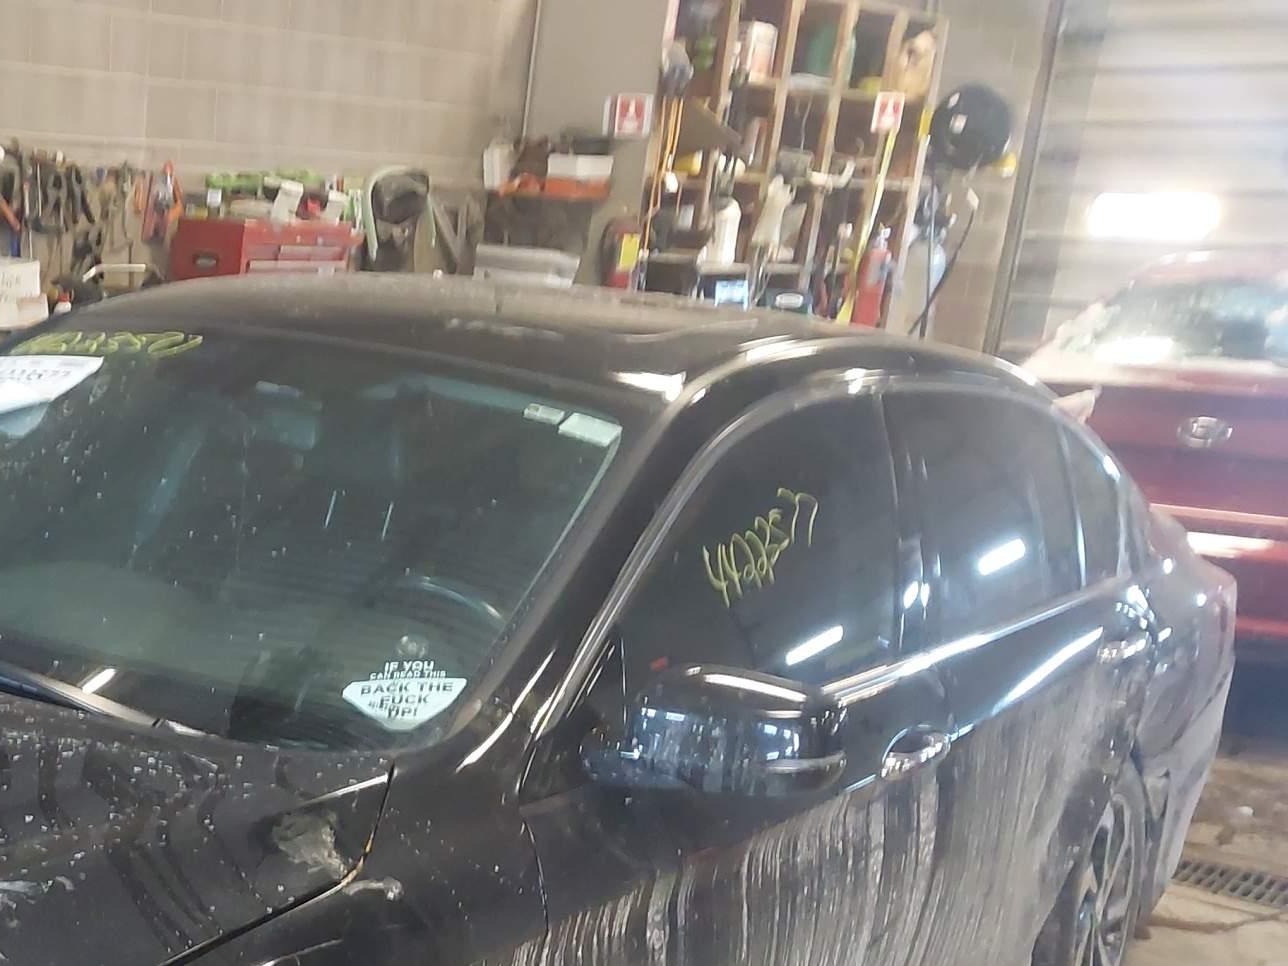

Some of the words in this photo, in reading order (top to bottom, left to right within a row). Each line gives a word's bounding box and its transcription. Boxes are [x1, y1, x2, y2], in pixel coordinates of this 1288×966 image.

[385, 661, 400, 673] IF
[403, 660, 434, 673] YOU
[370, 671, 390, 680] CAN
[394, 670, 421, 679] READ
[424, 669, 447, 679] THIS
[360, 683, 411, 696] BACK
[416, 681, 454, 693] THE
[379, 694, 431, 708] FUCK
[387, 706, 418, 719] UP!
